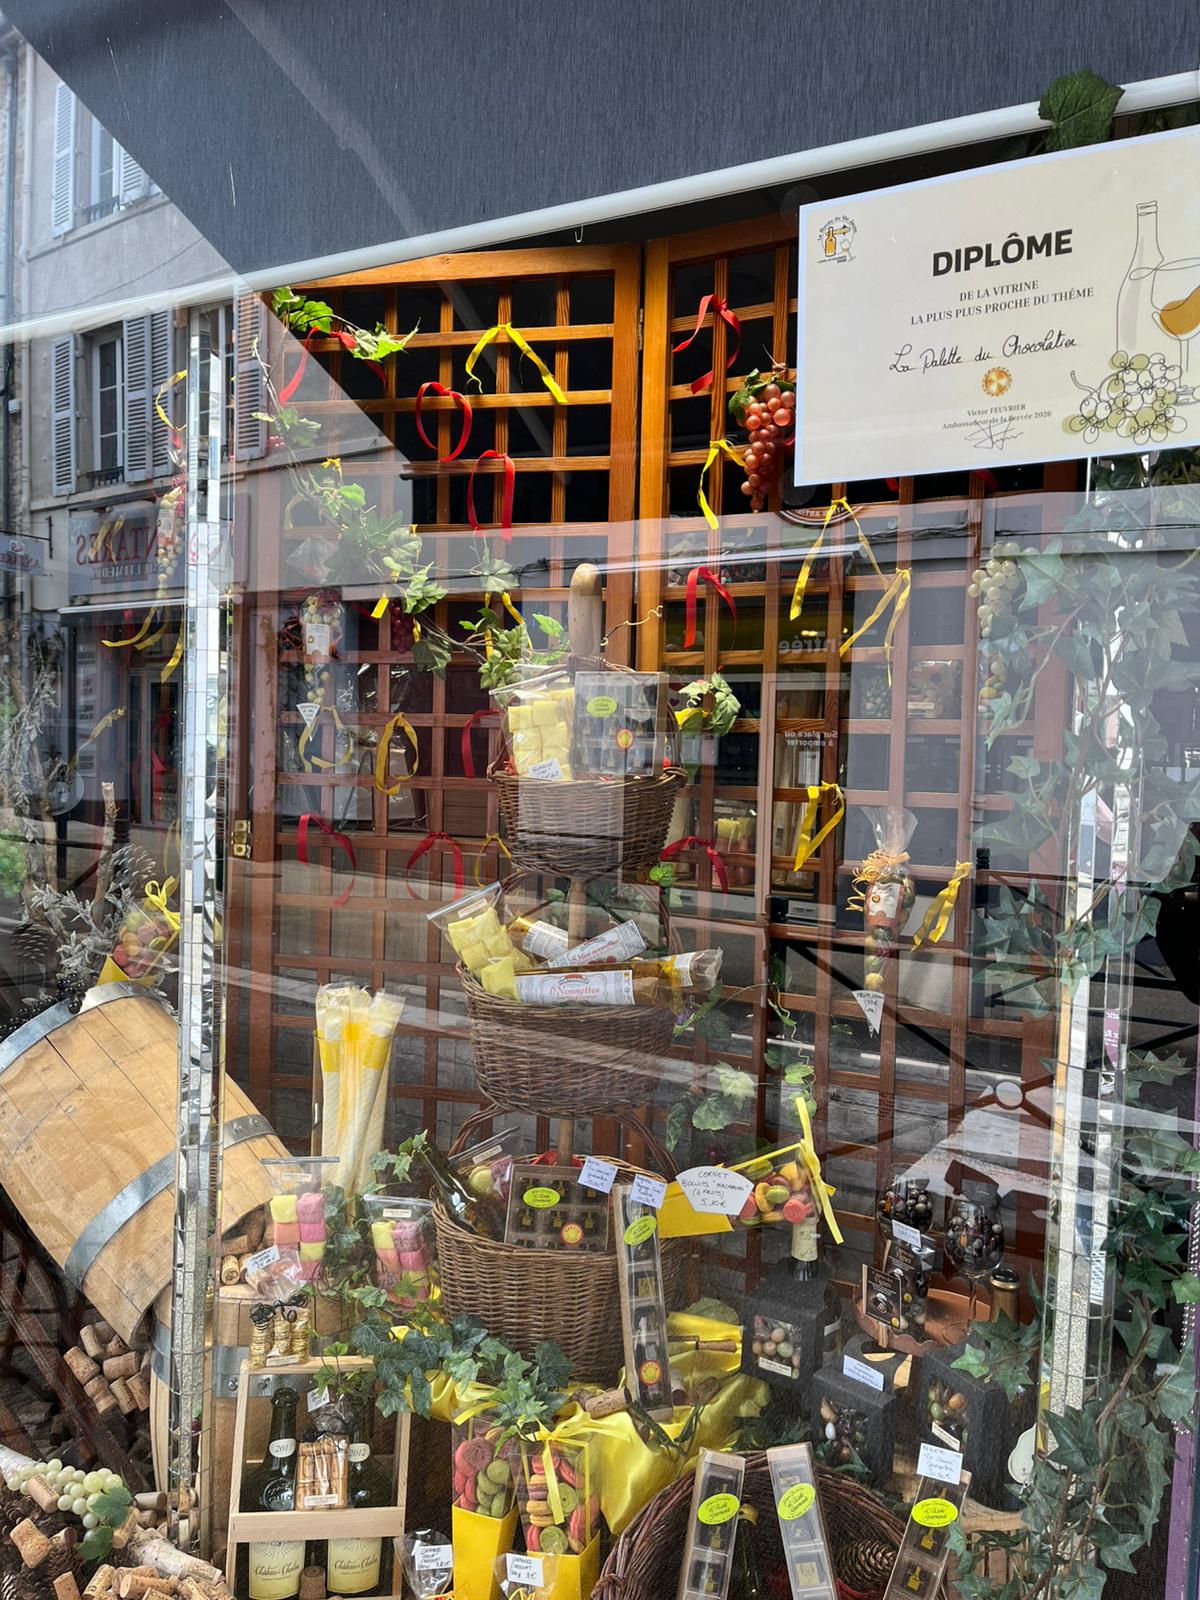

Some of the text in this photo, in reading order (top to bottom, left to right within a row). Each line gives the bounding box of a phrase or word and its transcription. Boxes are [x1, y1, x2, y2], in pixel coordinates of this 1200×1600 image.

[932, 228, 1073, 277] DIPLÔME
[960, 280, 1039, 301] DE LA VITRINE
[911, 287, 1095, 325] LA PLUS PLUS PROCHE DU THÊME
[889, 329, 1077, 374] La Palette du Chocolatier
[967, 408, 989, 417] Victor
[1034, 410, 1052, 419] 2026
